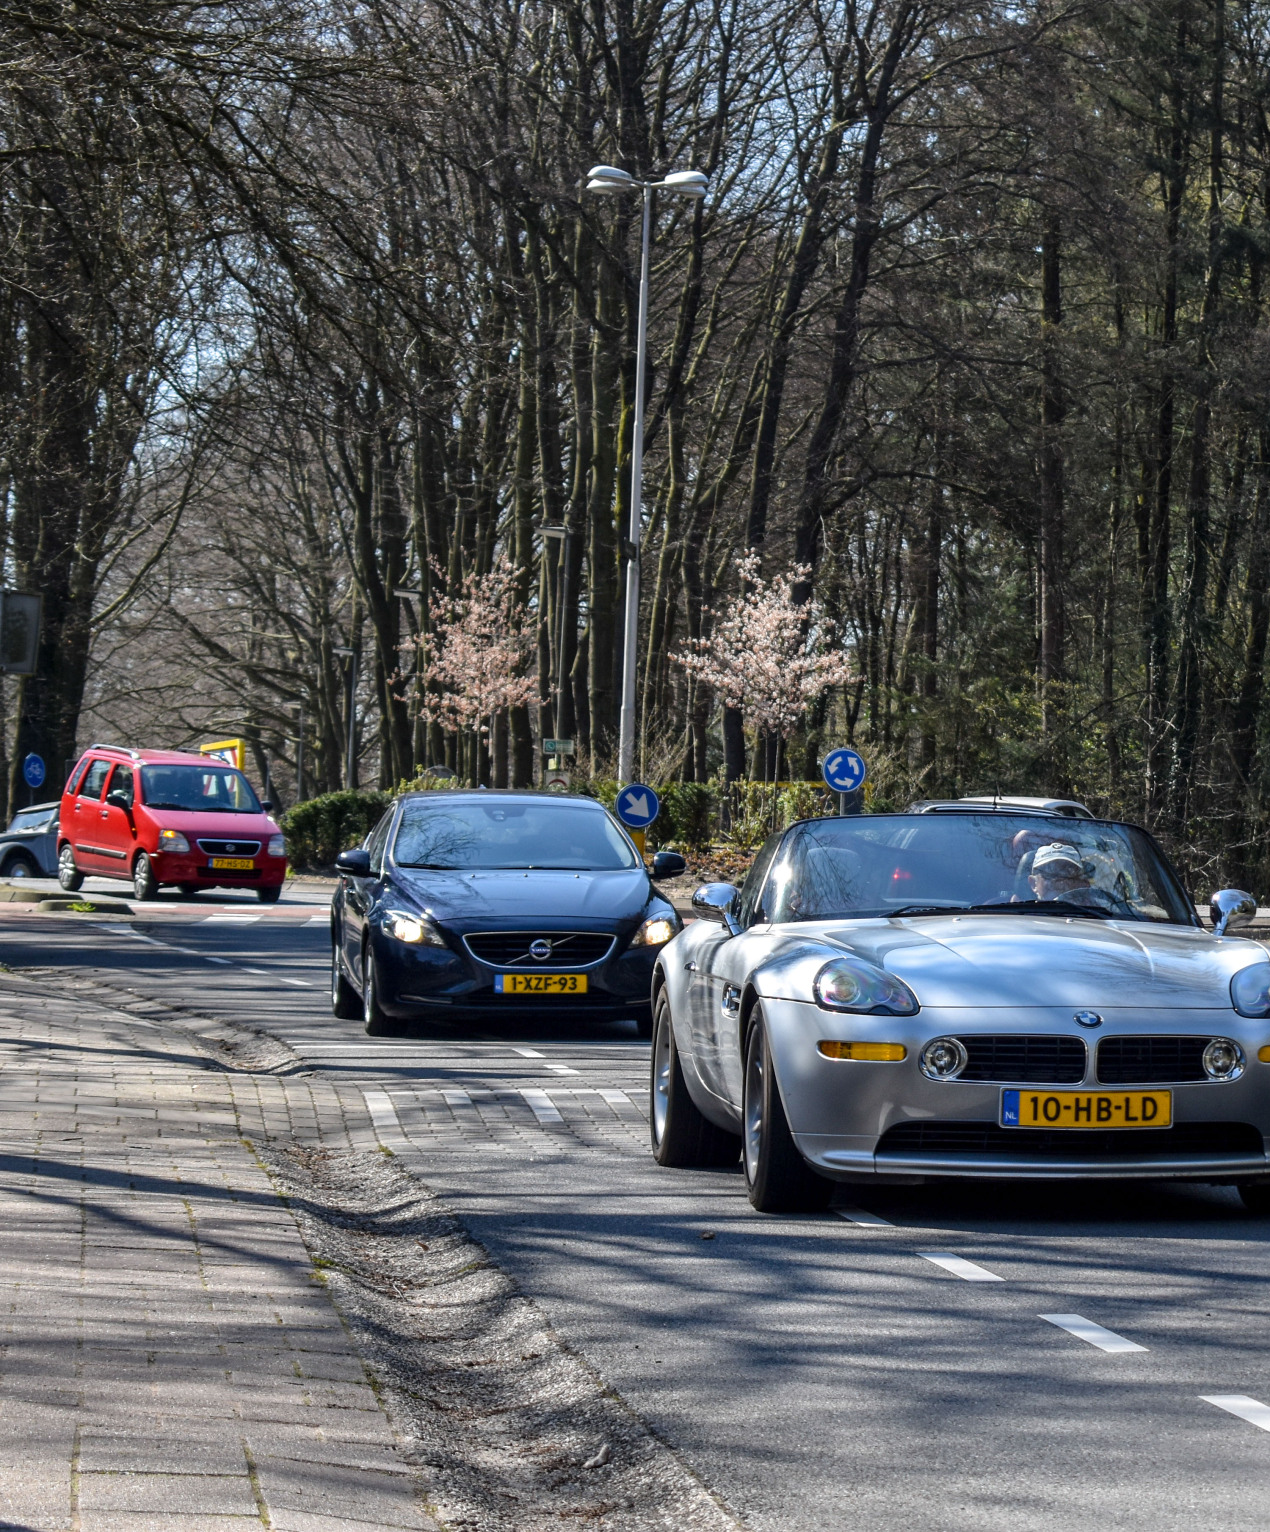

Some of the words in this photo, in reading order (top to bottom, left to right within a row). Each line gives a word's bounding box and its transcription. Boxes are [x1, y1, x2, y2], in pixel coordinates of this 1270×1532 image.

[511, 976, 577, 991] 1-XZF-93
[1005, 1111, 1017, 1120] NL
[1030, 1096, 1158, 1122] 10-HB-LD
